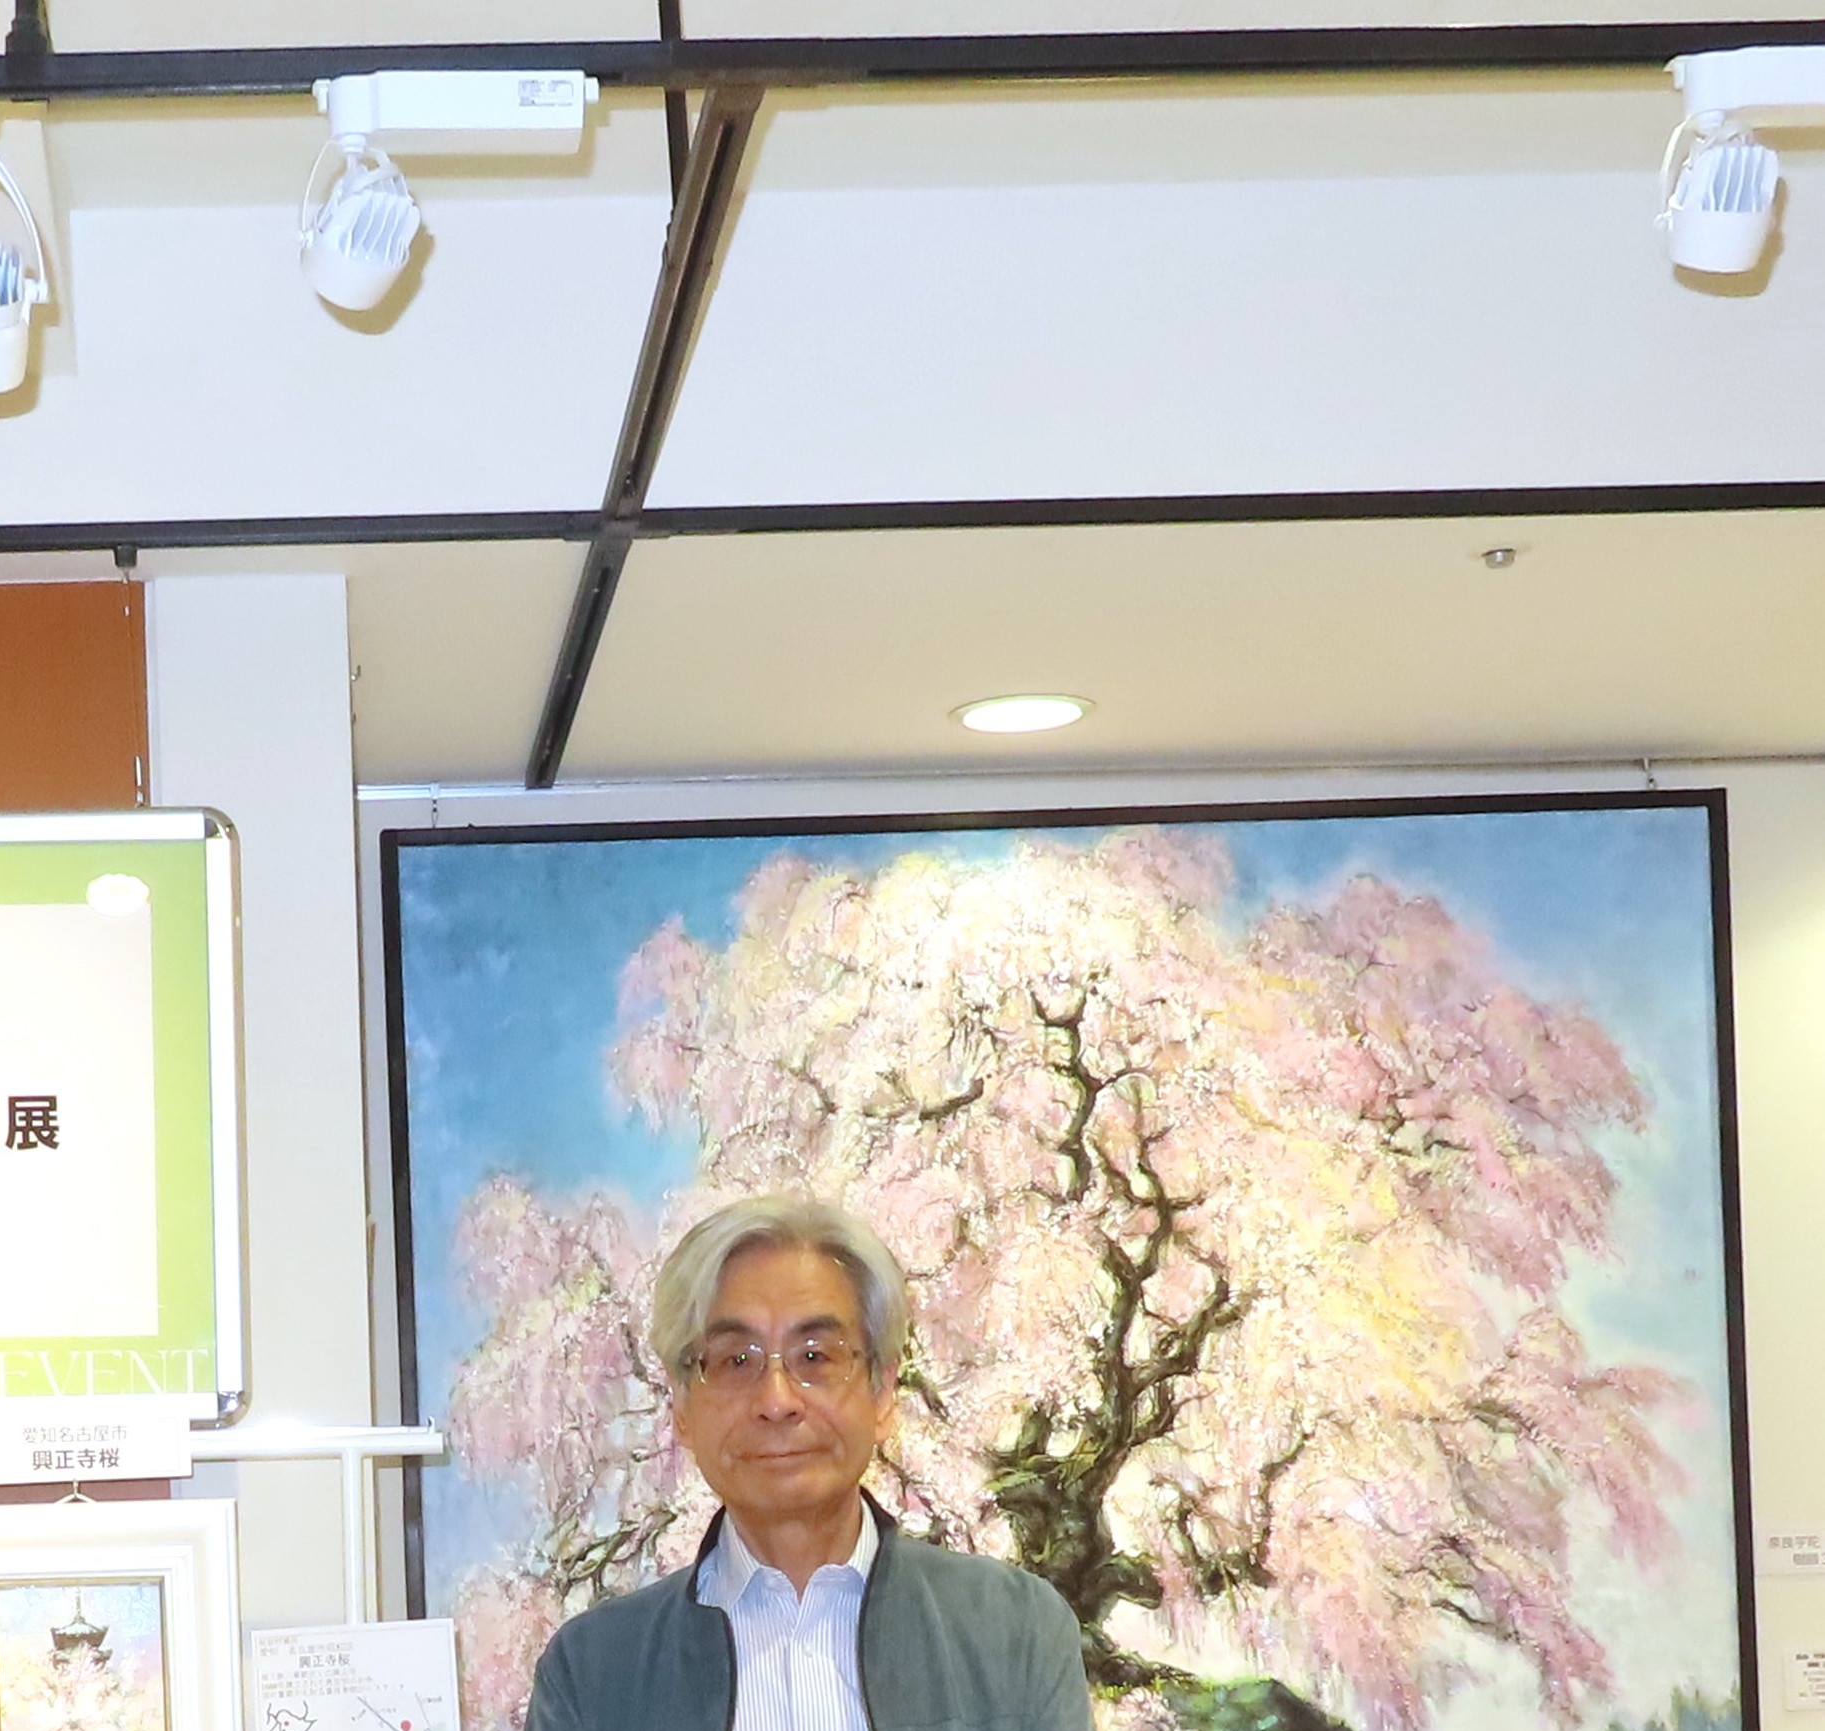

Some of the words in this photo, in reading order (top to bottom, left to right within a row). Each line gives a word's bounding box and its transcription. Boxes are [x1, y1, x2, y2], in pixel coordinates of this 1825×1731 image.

[23, 1425, 128, 1444] 愛知名古屋市
[32, 1447, 120, 1471] 興正寺桜
